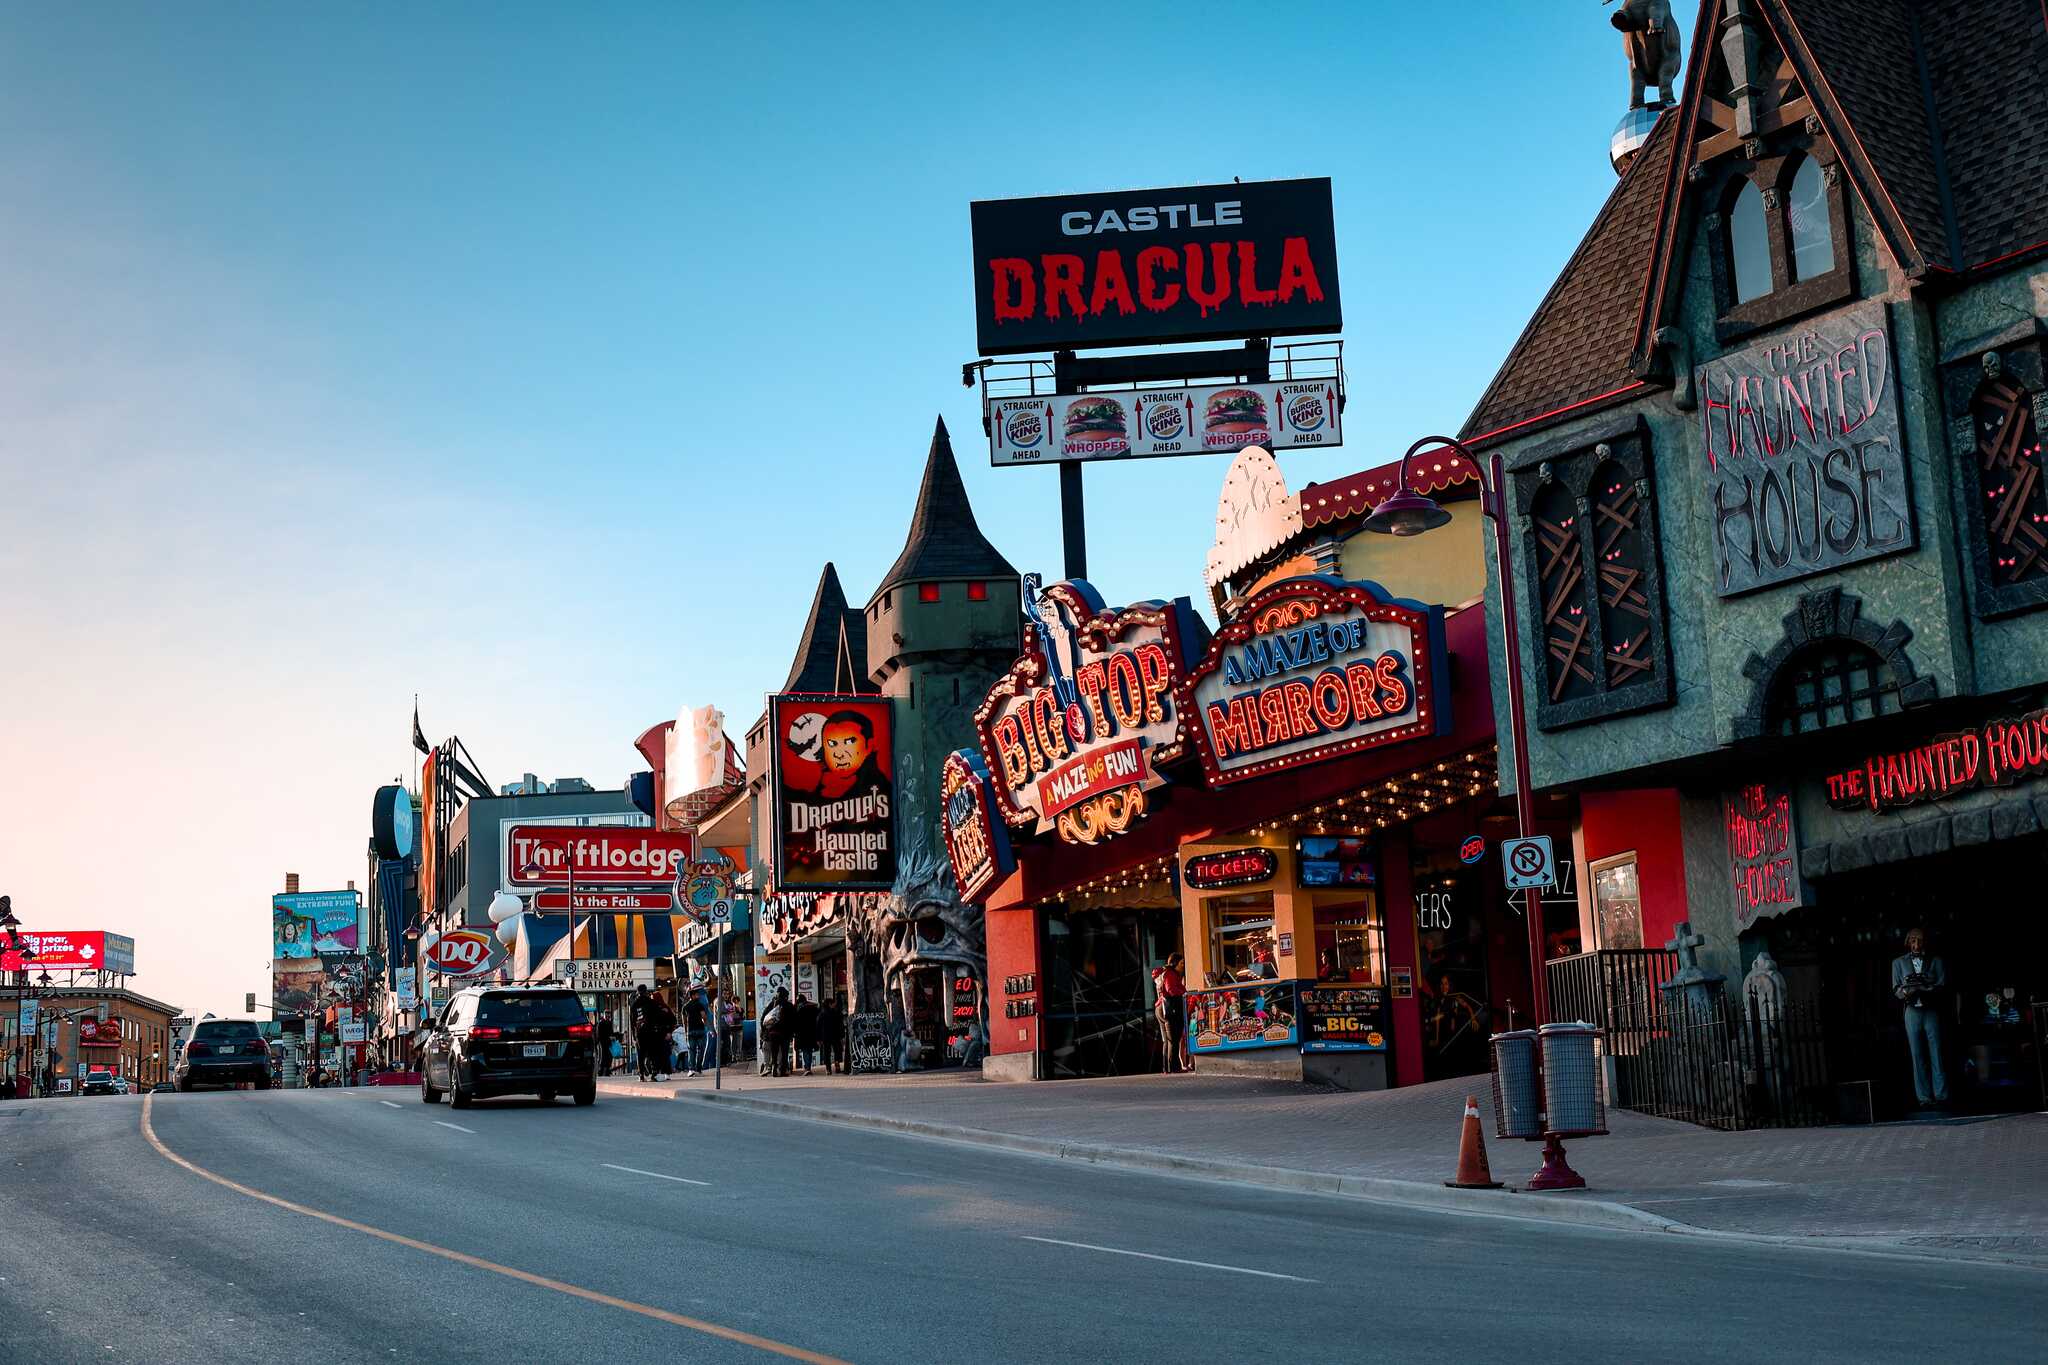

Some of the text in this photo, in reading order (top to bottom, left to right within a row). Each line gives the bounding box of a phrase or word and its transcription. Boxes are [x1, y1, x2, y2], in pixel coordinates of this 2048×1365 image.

[1061, 200, 1243, 236] CASTLE
[988, 236, 1325, 325] DRACULA
[1764, 332, 1818, 370] THE
[1143, 393, 1184, 403] STRAIGHT
[1283, 384, 1325, 394] STRAIGHT
[1003, 400, 1044, 411] STRAIGHT
[1290, 399, 1321, 415] BURGER
[1701, 328, 1887, 474] HAUNTED
[1009, 417, 1040, 432] BURGER
[1149, 408, 1180, 424] BURGER
[1151, 415, 1182, 434] KING
[1292, 406, 1323, 425] KING
[1010, 424, 1041, 441] KING
[1205, 432, 1268, 446] WHOPPER
[1293, 433, 1322, 443] AHEAD
[1012, 450, 1041, 460] AHEAD
[1064, 440, 1127, 454] WHOPPER
[1152, 442, 1181, 452] AHEAD
[1714, 436, 1904, 589] HOUSE
[1243, 623, 1329, 682] MAZE
[1329, 618, 1362, 654] OF
[992, 645, 1169, 791] BIG TOP
[1103, 747, 1138, 780] FUN!
[1826, 712, 2048, 810] THE HAUNTED HOUS
[1725, 795, 1789, 861] HAUNTED
[815, 828, 888, 853] Haunted
[1461, 839, 1485, 859] OPEN
[515, 838, 686, 877] Thrftlodge
[823, 849, 879, 871] Castle
[1195, 858, 1259, 877] TICKETS
[1732, 859, 1794, 920] HOUSE
[297, 900, 334, 908] EXTREME
[586, 895, 610, 907] the
[612, 895, 641, 907] Falls
[1416, 893, 1452, 929] ERS
[42, 935, 69, 945] year,
[42, 944, 75, 954] prizes
[439, 941, 481, 964] DQ
[582, 970, 633, 979] BREAKFAST
[587, 961, 628, 970] SERVING
[582, 980, 634, 989] DAILY 8AM
[1312, 1017, 1373, 1032] The BIG Fun
[852, 1034, 892, 1060] Haunted
[852, 1057, 892, 1069] CASTLE
